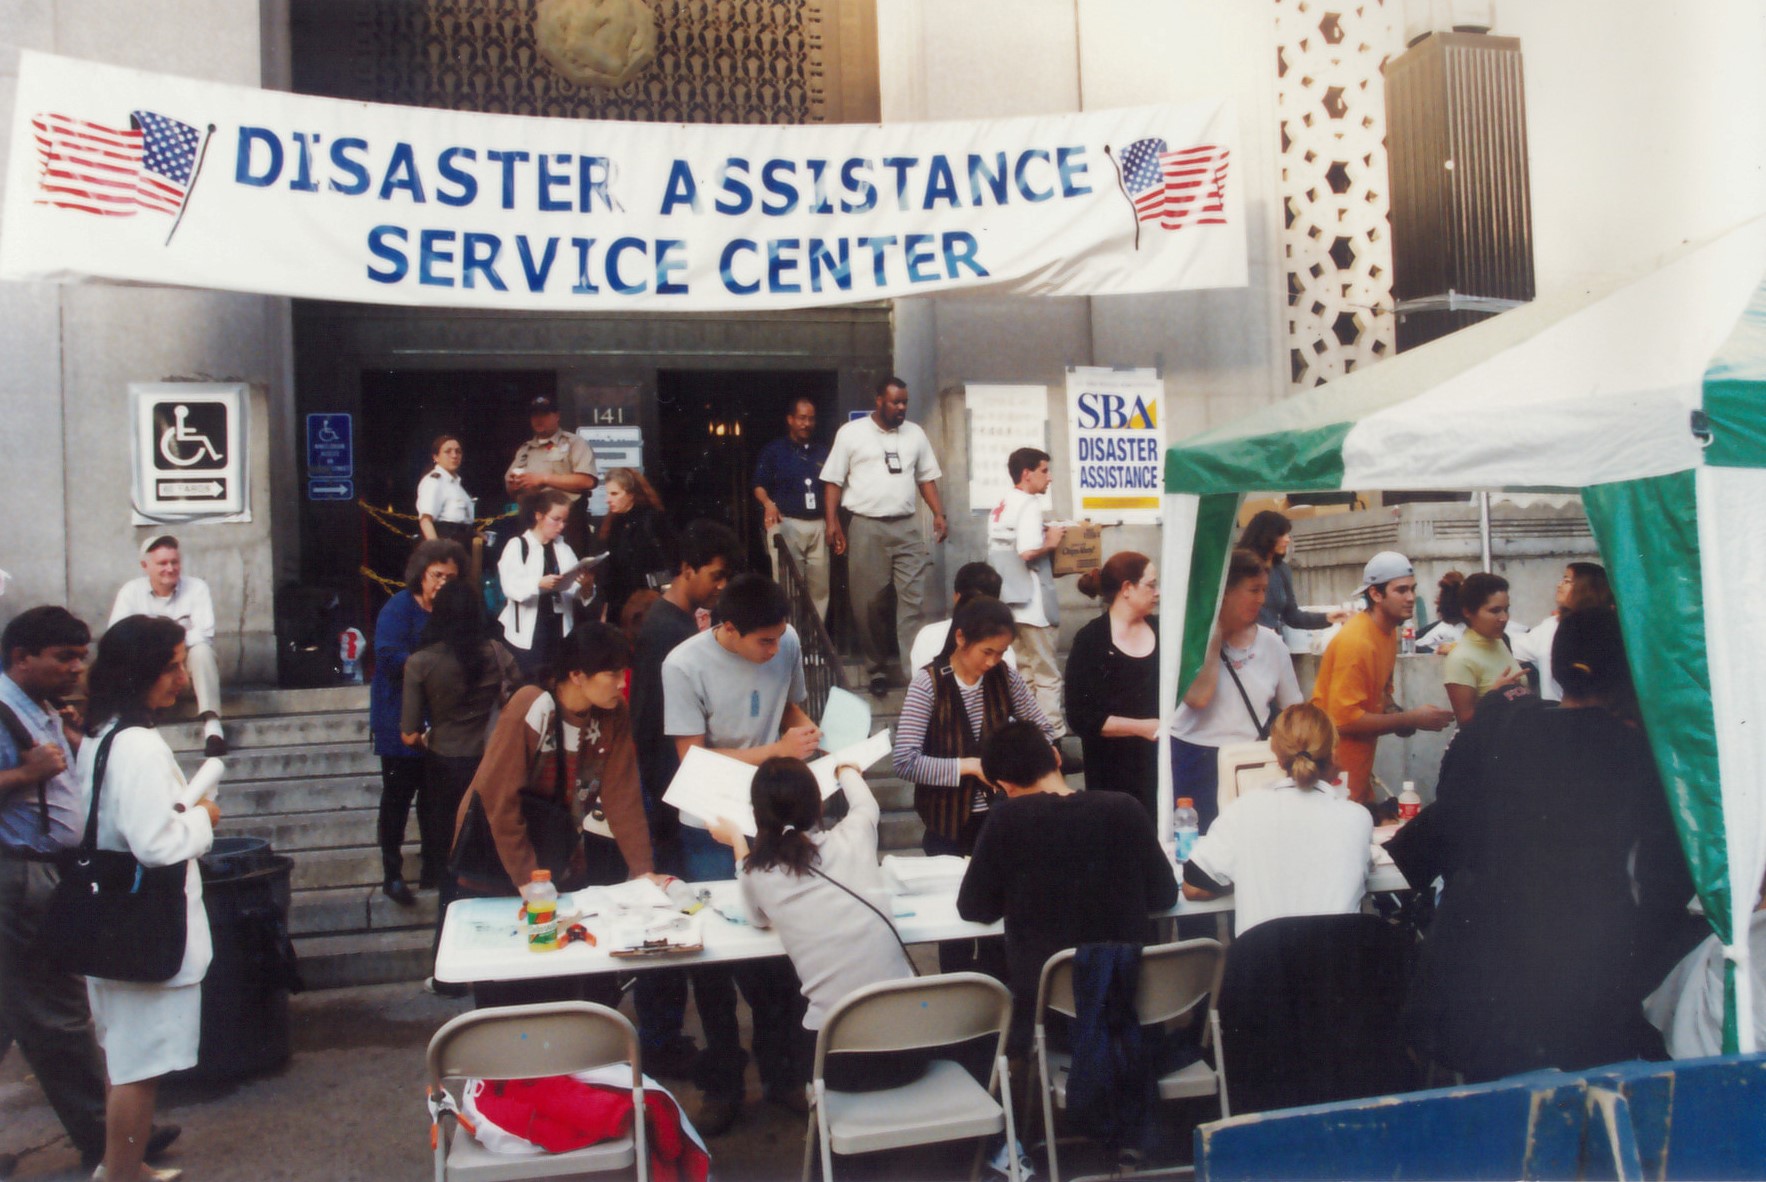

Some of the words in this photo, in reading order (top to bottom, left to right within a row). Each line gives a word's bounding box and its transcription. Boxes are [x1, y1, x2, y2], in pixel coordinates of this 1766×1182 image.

[235, 126, 623, 213] DISASTER
[659, 146, 1093, 216] ASSISTANCE
[367, 224, 689, 296] SERVICE
[718, 230, 989, 296] CENTER
[593, 407, 623, 424] 141
[1078, 393, 1157, 430] SBA
[1078, 437, 1158, 462] DISASTER
[1080, 465, 1158, 489] ASSISTANCE
